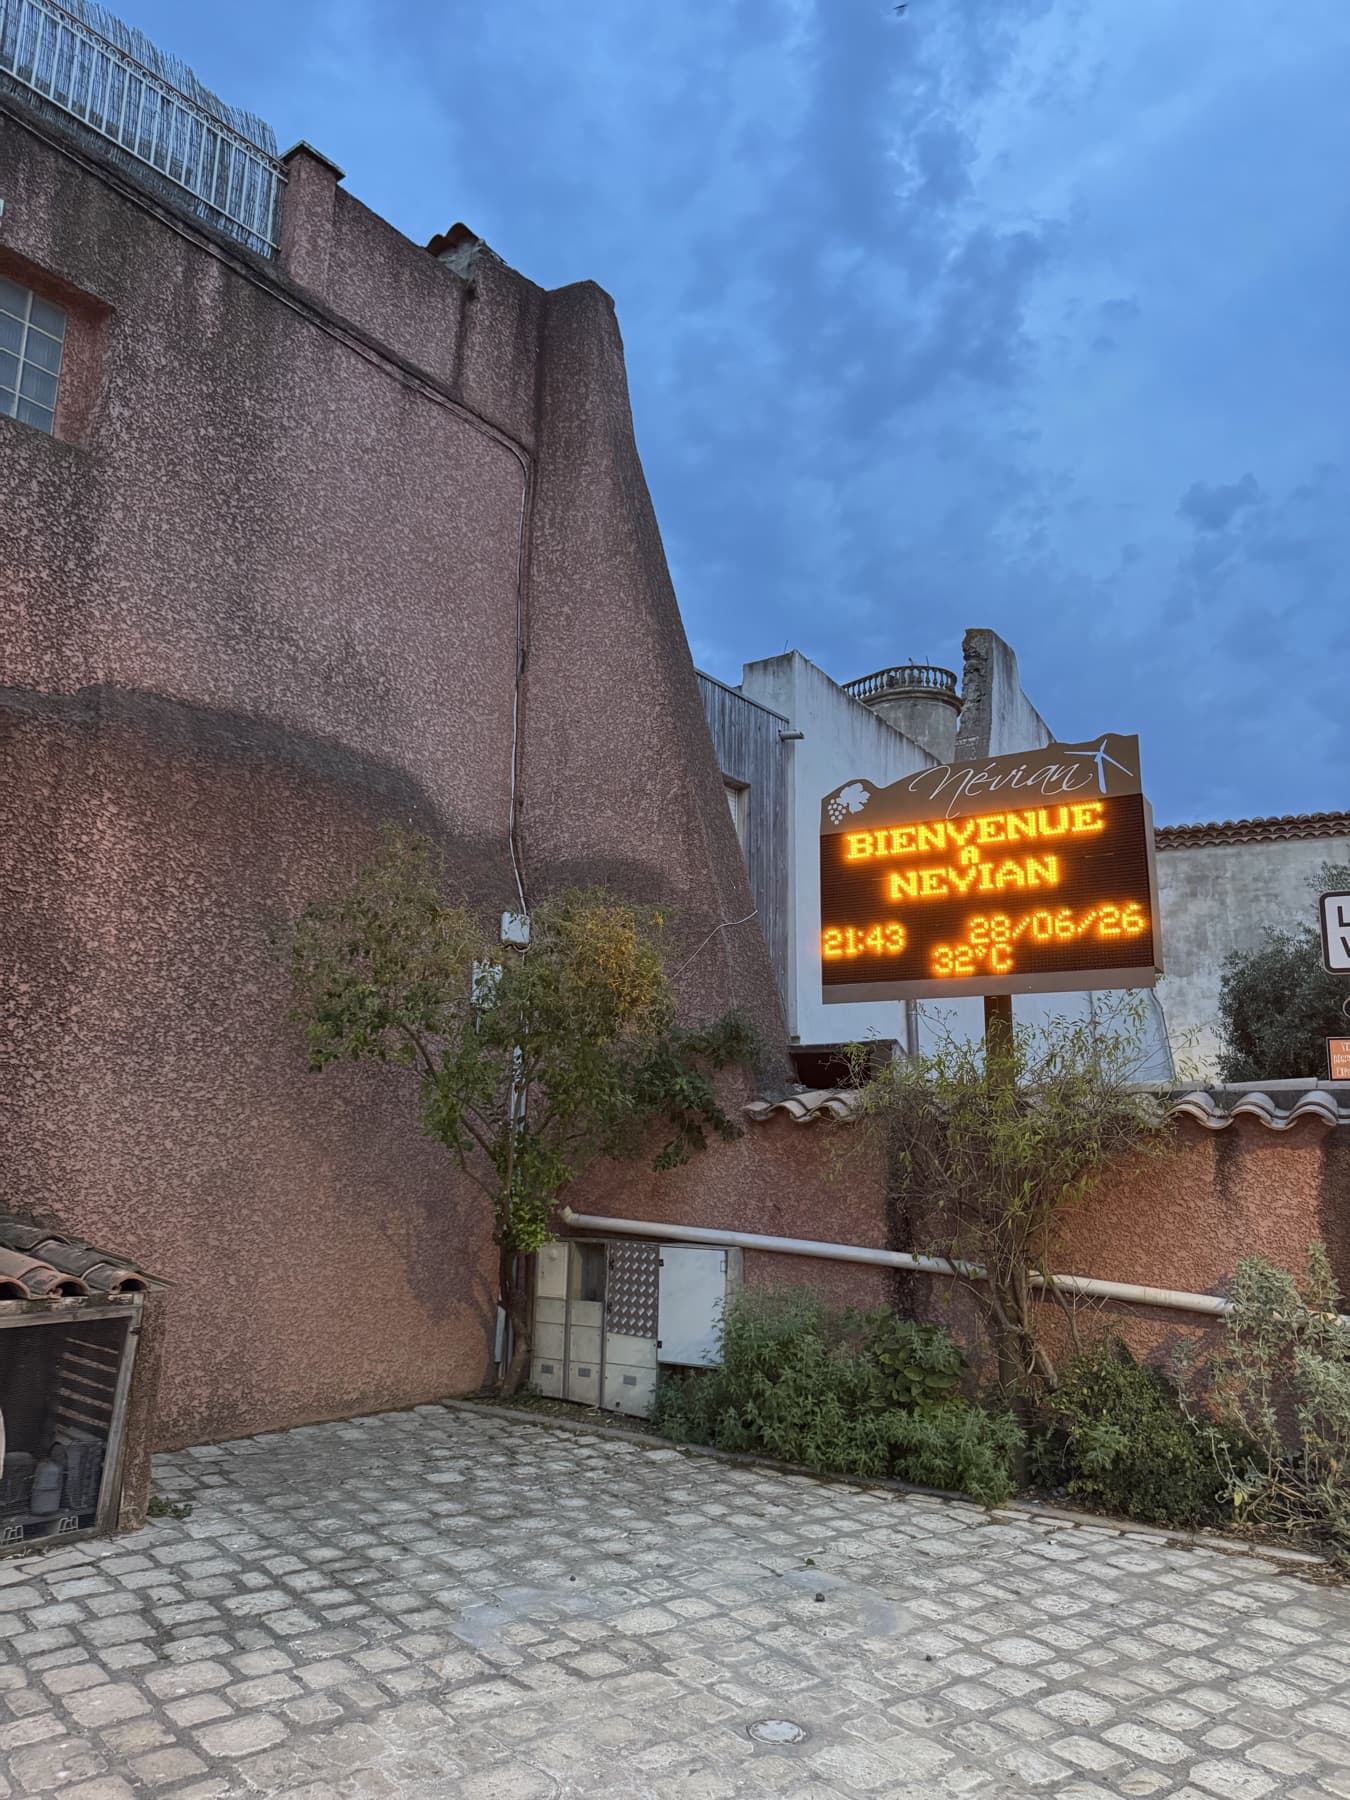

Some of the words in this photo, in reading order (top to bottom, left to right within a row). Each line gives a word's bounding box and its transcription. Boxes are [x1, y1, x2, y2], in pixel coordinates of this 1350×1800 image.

[908, 762, 1094, 820] Névian
[846, 801, 1104, 860] BIENVENUE
[889, 855, 1058, 899] NEVIAN
[823, 924, 904, 956] 21:43
[969, 903, 1145, 945] 28/06/26
[933, 943, 1013, 974] 32°C
